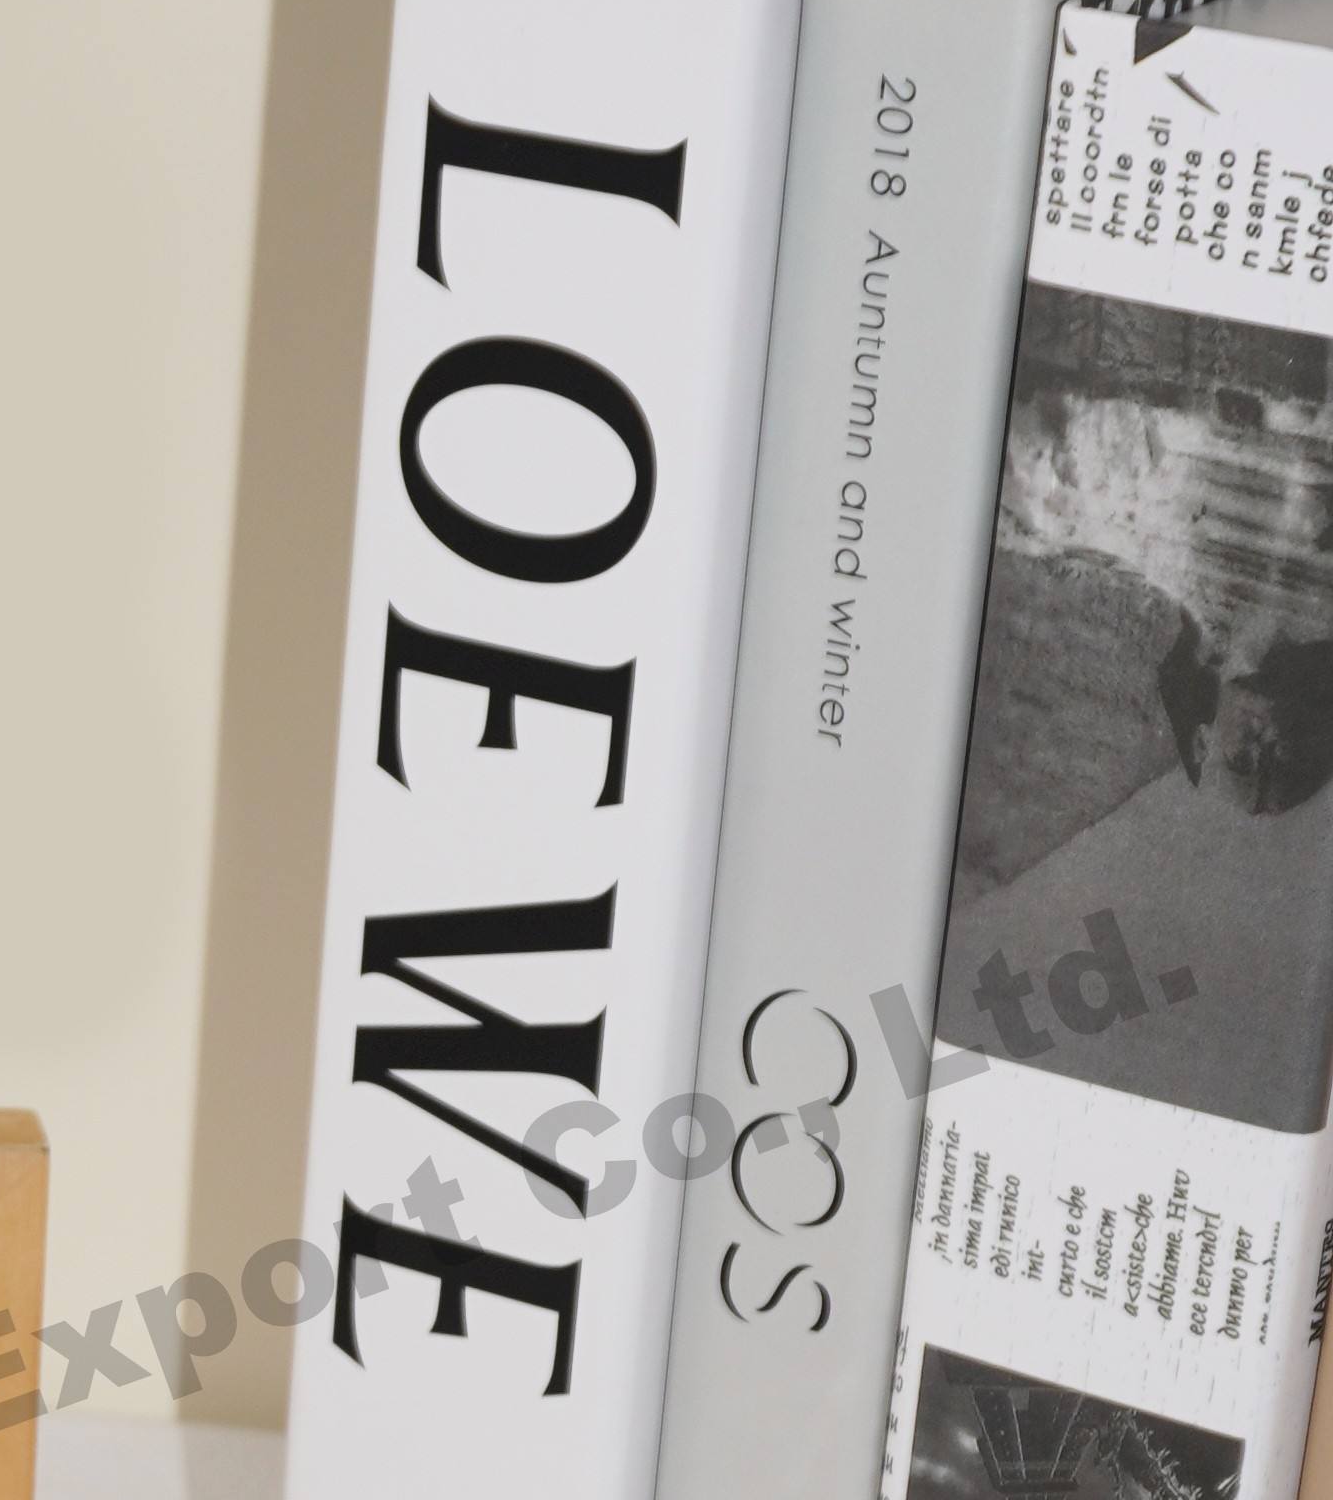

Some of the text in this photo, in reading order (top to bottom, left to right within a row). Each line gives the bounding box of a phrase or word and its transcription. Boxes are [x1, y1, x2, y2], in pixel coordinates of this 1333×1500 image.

[1045, 79, 1075, 226] spettare
[1108, 153, 1133, 182] le
[1133, 115, 1172, 247] forse di
[1202, 149, 1237, 262] che co
[817, 73, 917, 749] 2018 Auntumn and winter
[333, 94, 687, 1398] LOEWE
[718, 988, 858, 1333] COS
[958, 1151, 994, 1270] sima impat
[1056, 1185, 1088, 1221] che
[1065, 1223, 1082, 1237] e
[1233, 1225, 1259, 1266] per
[1080, 1279, 1108, 1300] il
[1189, 1302, 1208, 1337] ece
